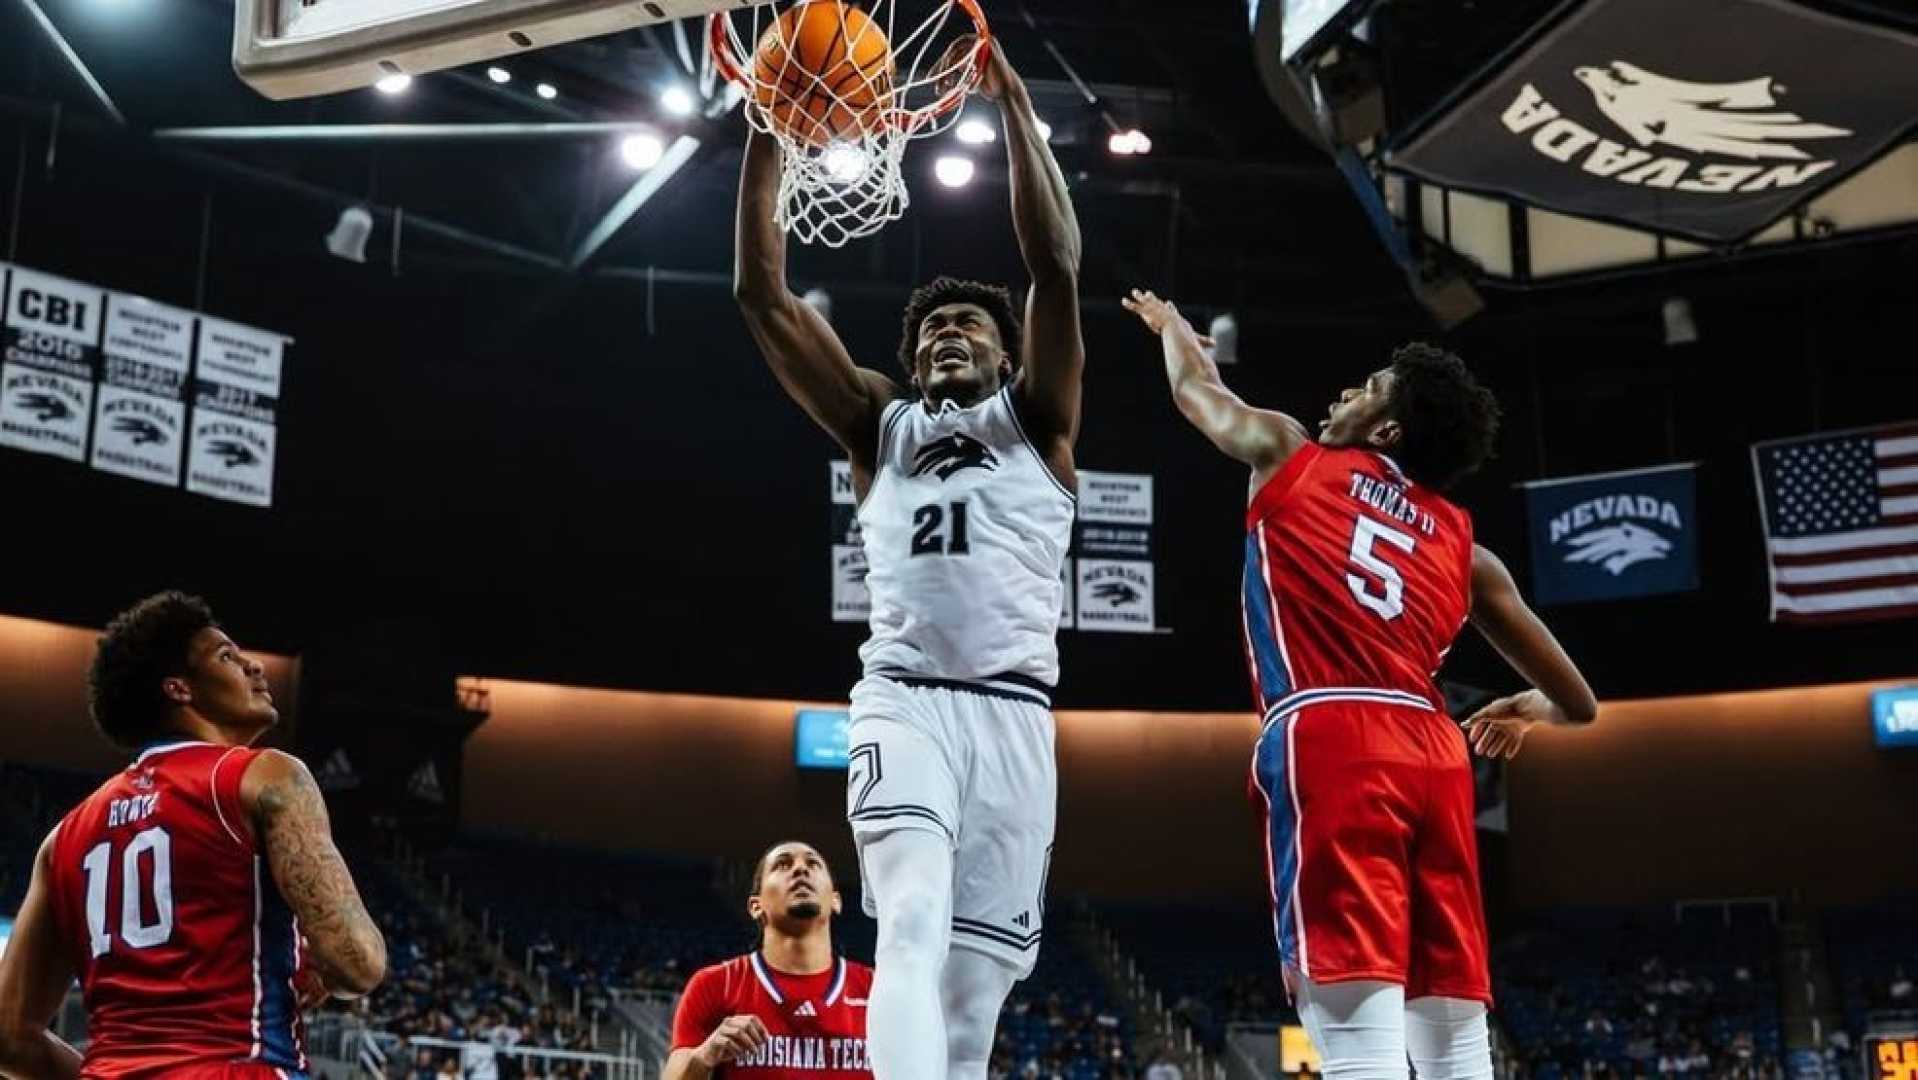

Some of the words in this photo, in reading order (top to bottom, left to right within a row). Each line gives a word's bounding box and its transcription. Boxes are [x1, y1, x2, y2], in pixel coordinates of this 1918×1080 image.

[1501, 83, 1836, 193] NEVADA
[18, 288, 86, 331] CBI
[7, 374, 84, 407] NEVADA
[104, 399, 177, 431] NEVADA
[198, 421, 268, 452] NEVADA
[1351, 472, 1418, 525] THOMAS
[1549, 494, 1682, 544] NEVADA
[911, 501, 970, 556] 21
[1082, 565, 1148, 587] NEVADA
[1346, 513, 1416, 622] 5
[83, 826, 173, 959] 10
